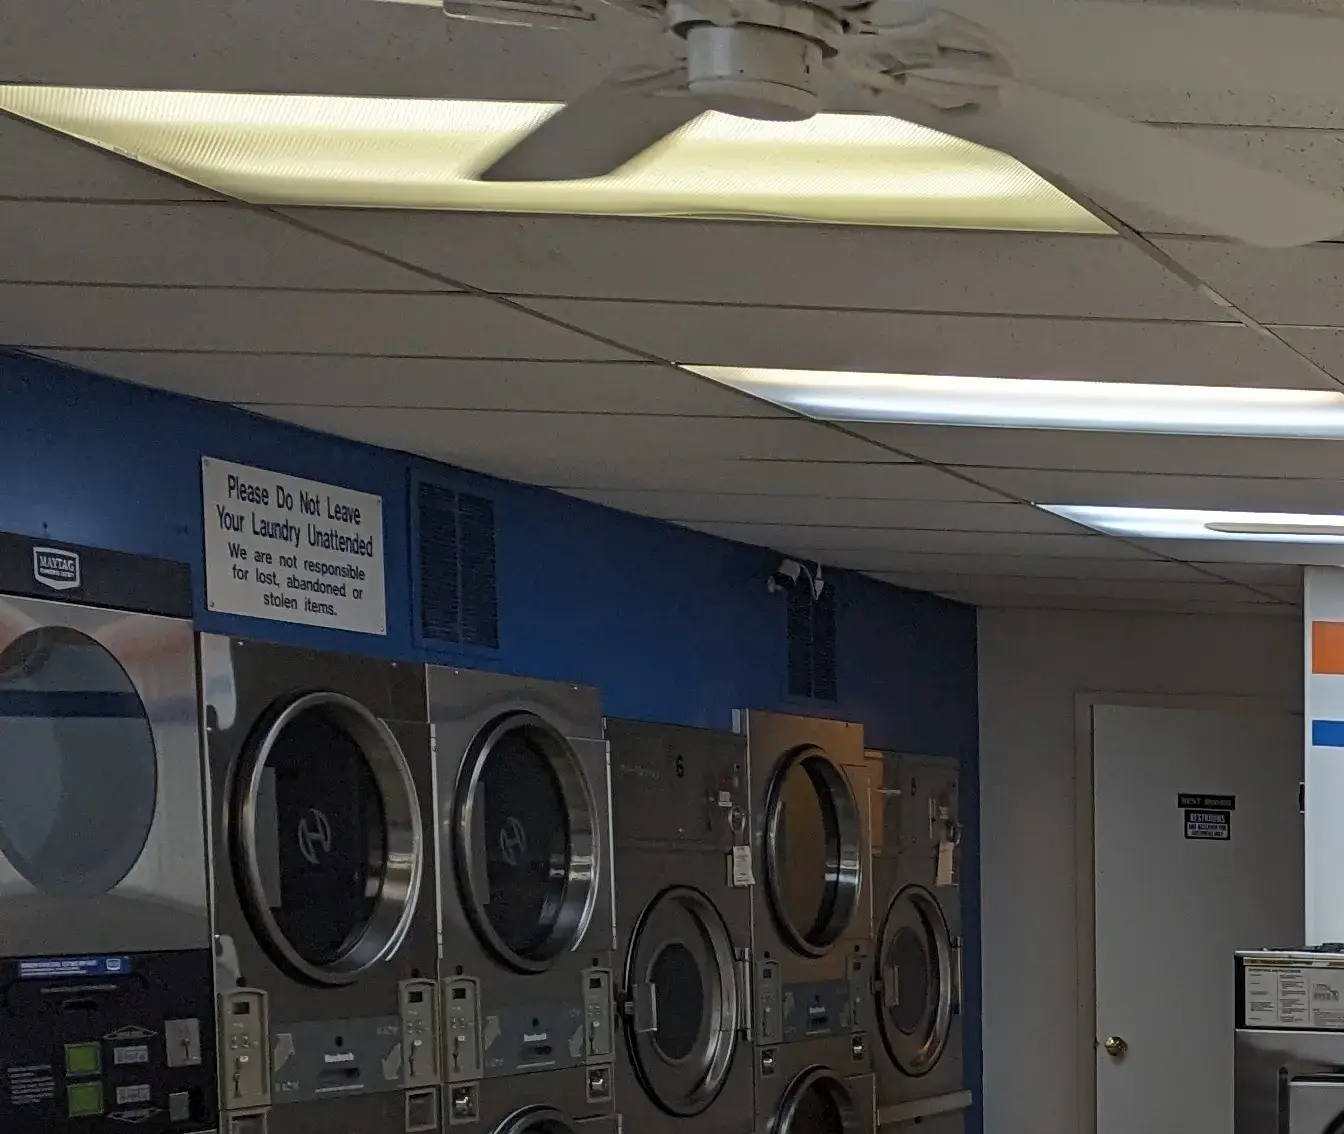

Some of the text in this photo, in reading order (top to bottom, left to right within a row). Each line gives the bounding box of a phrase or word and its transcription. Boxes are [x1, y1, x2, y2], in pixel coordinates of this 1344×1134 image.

[227, 474, 361, 525] Please Do Not Leave
[216, 504, 373, 557] Your Laundry Unattended
[40, 556, 74, 571] MAYTAG
[228, 542, 366, 580] We are not responsible
[232, 564, 363, 600] for lost, abandoned or
[264, 593, 337, 616] stolen items.
